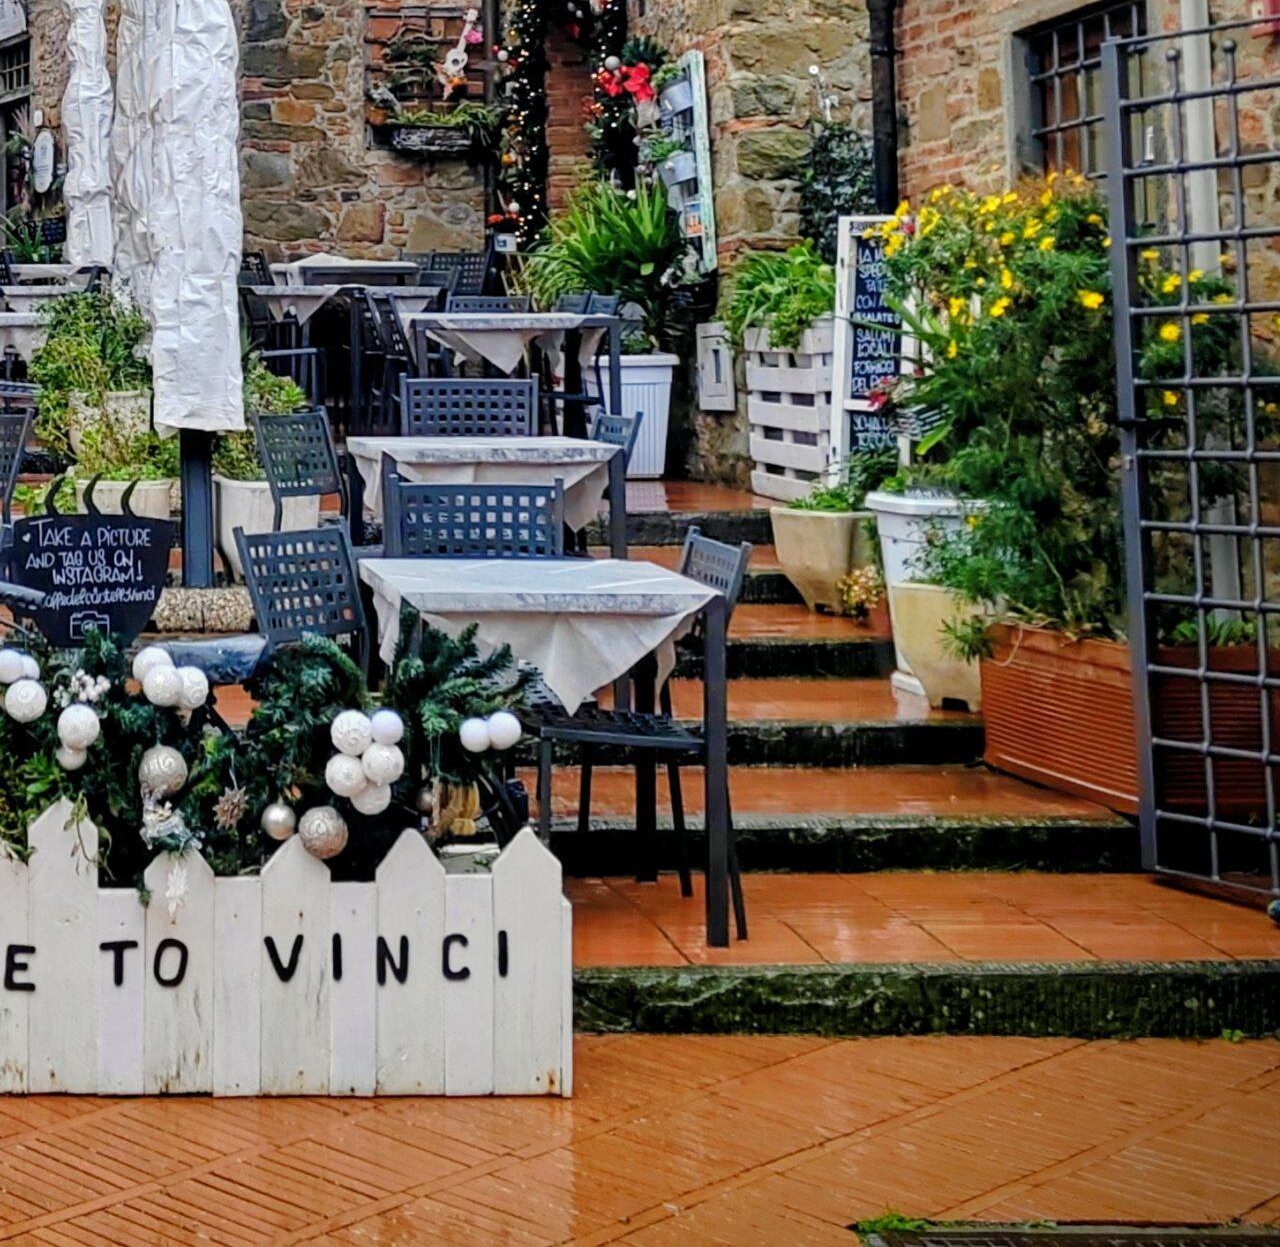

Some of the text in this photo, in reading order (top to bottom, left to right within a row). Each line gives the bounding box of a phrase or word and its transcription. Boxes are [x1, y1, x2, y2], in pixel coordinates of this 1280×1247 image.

[856, 329, 896, 344] SALUMI
[29, 518, 74, 547] TAKE
[80, 531, 92, 546] A
[25, 548, 133, 570] AND TAG US ON
[52, 559, 144, 585] INSTAGRAM!
[98, 937, 189, 989] TO
[263, 929, 510, 985] VINCI
